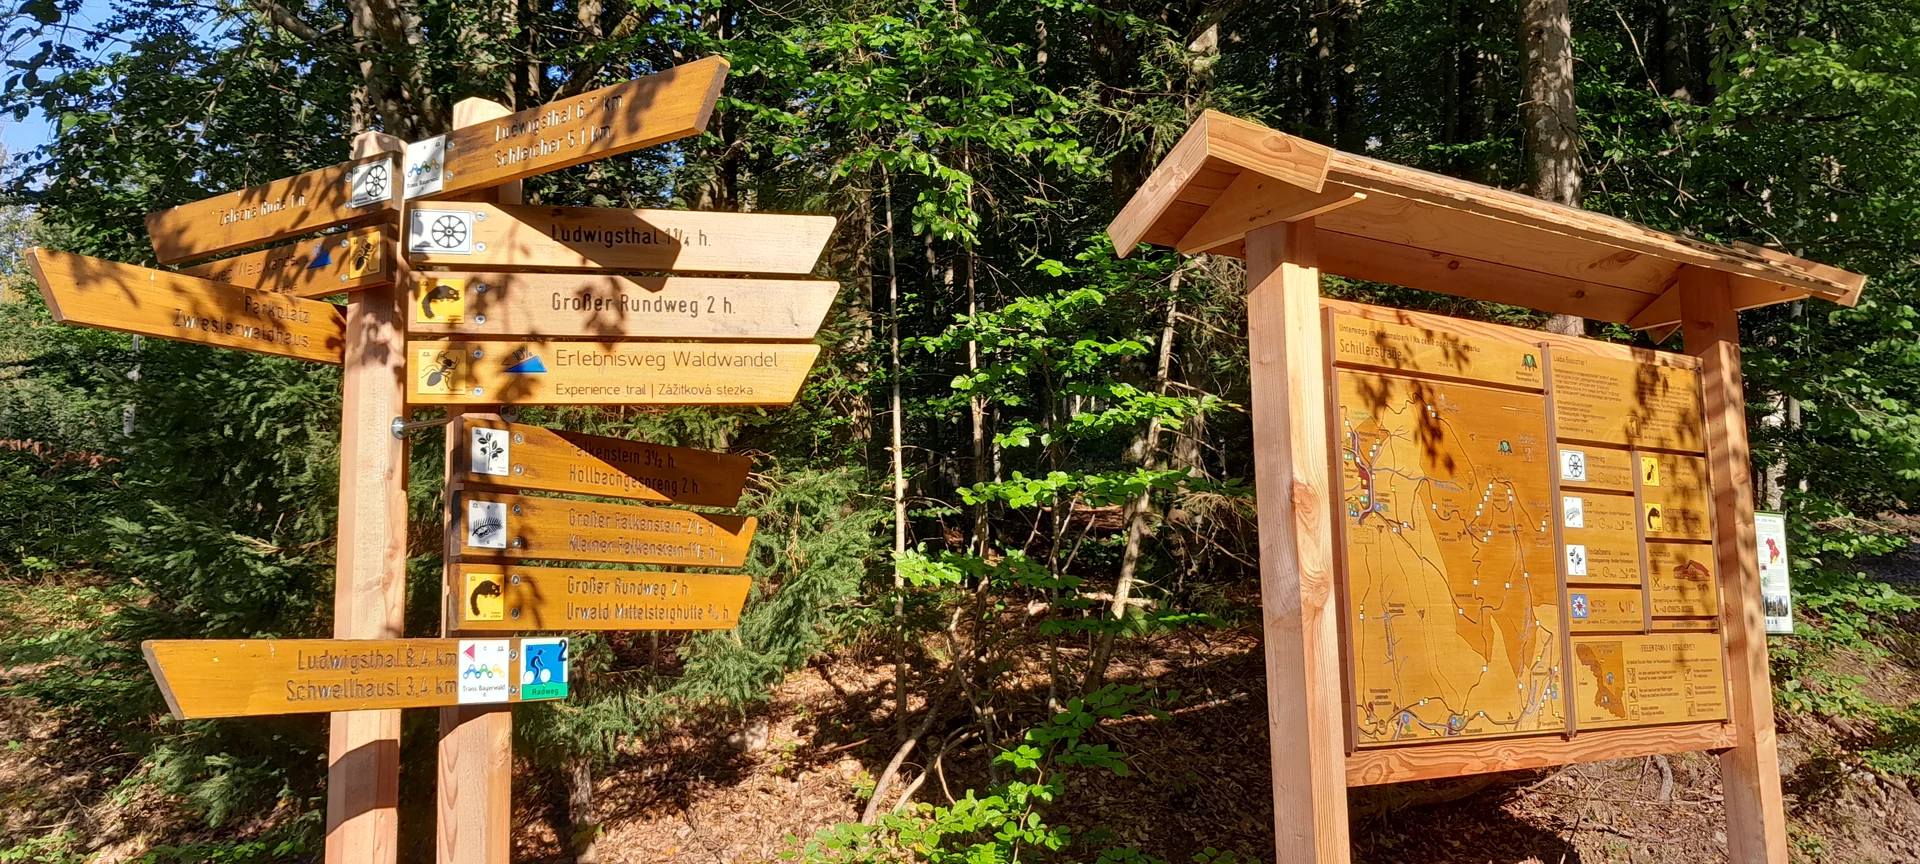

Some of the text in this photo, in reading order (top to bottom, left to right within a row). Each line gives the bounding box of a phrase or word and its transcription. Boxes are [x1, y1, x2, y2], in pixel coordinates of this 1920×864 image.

[494, 104, 572, 142] Ludwigsthal
[602, 94, 622, 111] km
[494, 137, 563, 168] Schleicher
[590, 124, 610, 143] km
[551, 225, 659, 248] Ludwigsthal
[245, 295, 310, 323] Parkplatz
[552, 292, 613, 311] Großer
[620, 293, 699, 318] Rundweg
[706, 295, 715, 314] 2
[556, 349, 778, 371] Erlebnisweg Waldwandel
[1339, 338, 1402, 360] Schillerstraße
[556, 383, 620, 398] Experience
[626, 383, 646, 395] trail
[658, 383, 712, 395] Zážitková
[716, 384, 754, 395] stezka
[569, 439, 640, 465] Falkenstein
[569, 464, 678, 497] Höllbachgespreng
[682, 477, 688, 494] 2
[569, 508, 611, 527] Großer
[615, 511, 682, 534] Falkenstein
[569, 533, 614, 553] Kleiner
[618, 537, 685, 557] Falkenstein
[567, 575, 610, 595] Großer
[614, 577, 667, 600] Rundweg
[671, 579, 678, 597] 2
[567, 602, 610, 620] Urwald
[615, 601, 704, 624] Mittelsteighütte
[297, 649, 401, 675] Ludwigsthal
[436, 648, 457, 667] km
[558, 639, 568, 662] 2
[286, 676, 457, 702] Schwellhäusl 3.4 km
[479, 684, 506, 692] Bayerwald
